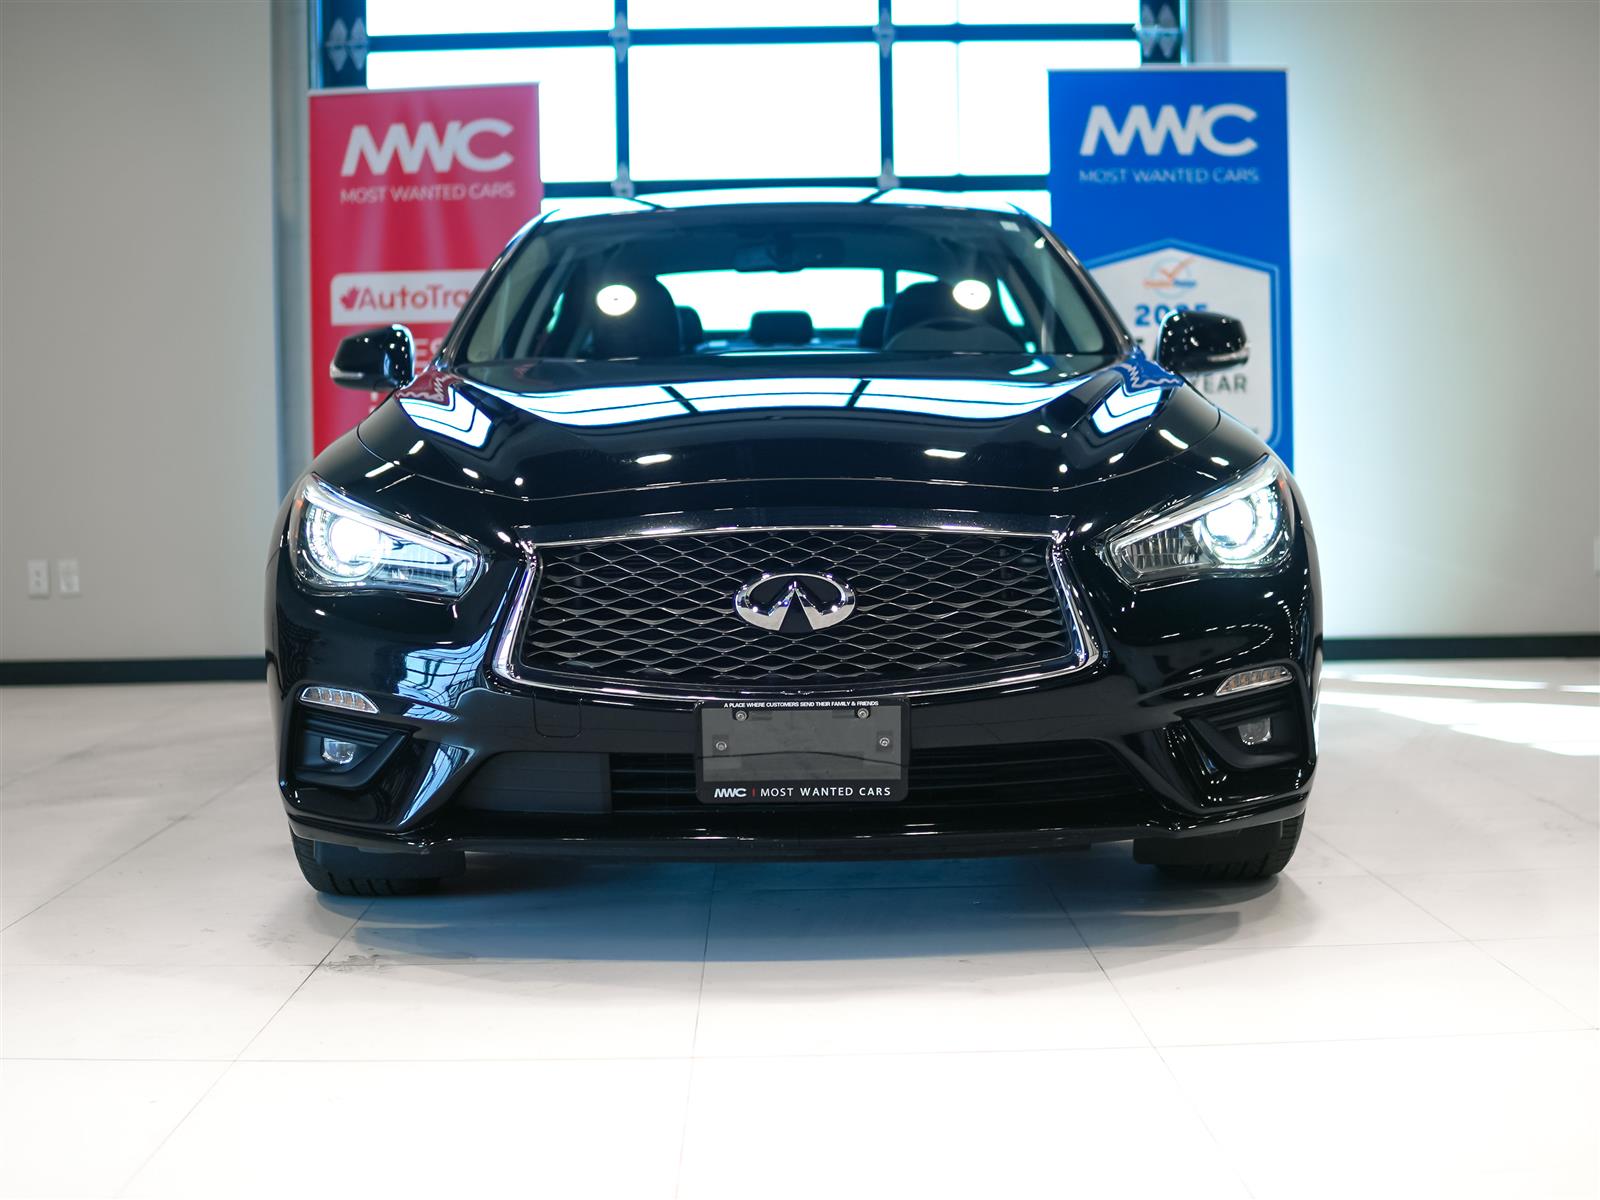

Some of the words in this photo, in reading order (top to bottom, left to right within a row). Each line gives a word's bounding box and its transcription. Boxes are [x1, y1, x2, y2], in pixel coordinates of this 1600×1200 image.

[1080, 104, 1258, 156] MWC
[341, 118, 514, 176] MWC
[1079, 168, 1127, 184] MOST
[1132, 168, 1208, 184] WANTED
[1212, 167, 1259, 184] CARS
[340, 187, 386, 204] MOST
[391, 183, 465, 202] WANTED
[468, 181, 515, 200] CARS
[714, 788, 747, 798] MWC
[760, 788, 794, 797] MOST
[800, 787, 854, 797] WANTED
[859, 787, 891, 796] CARS
